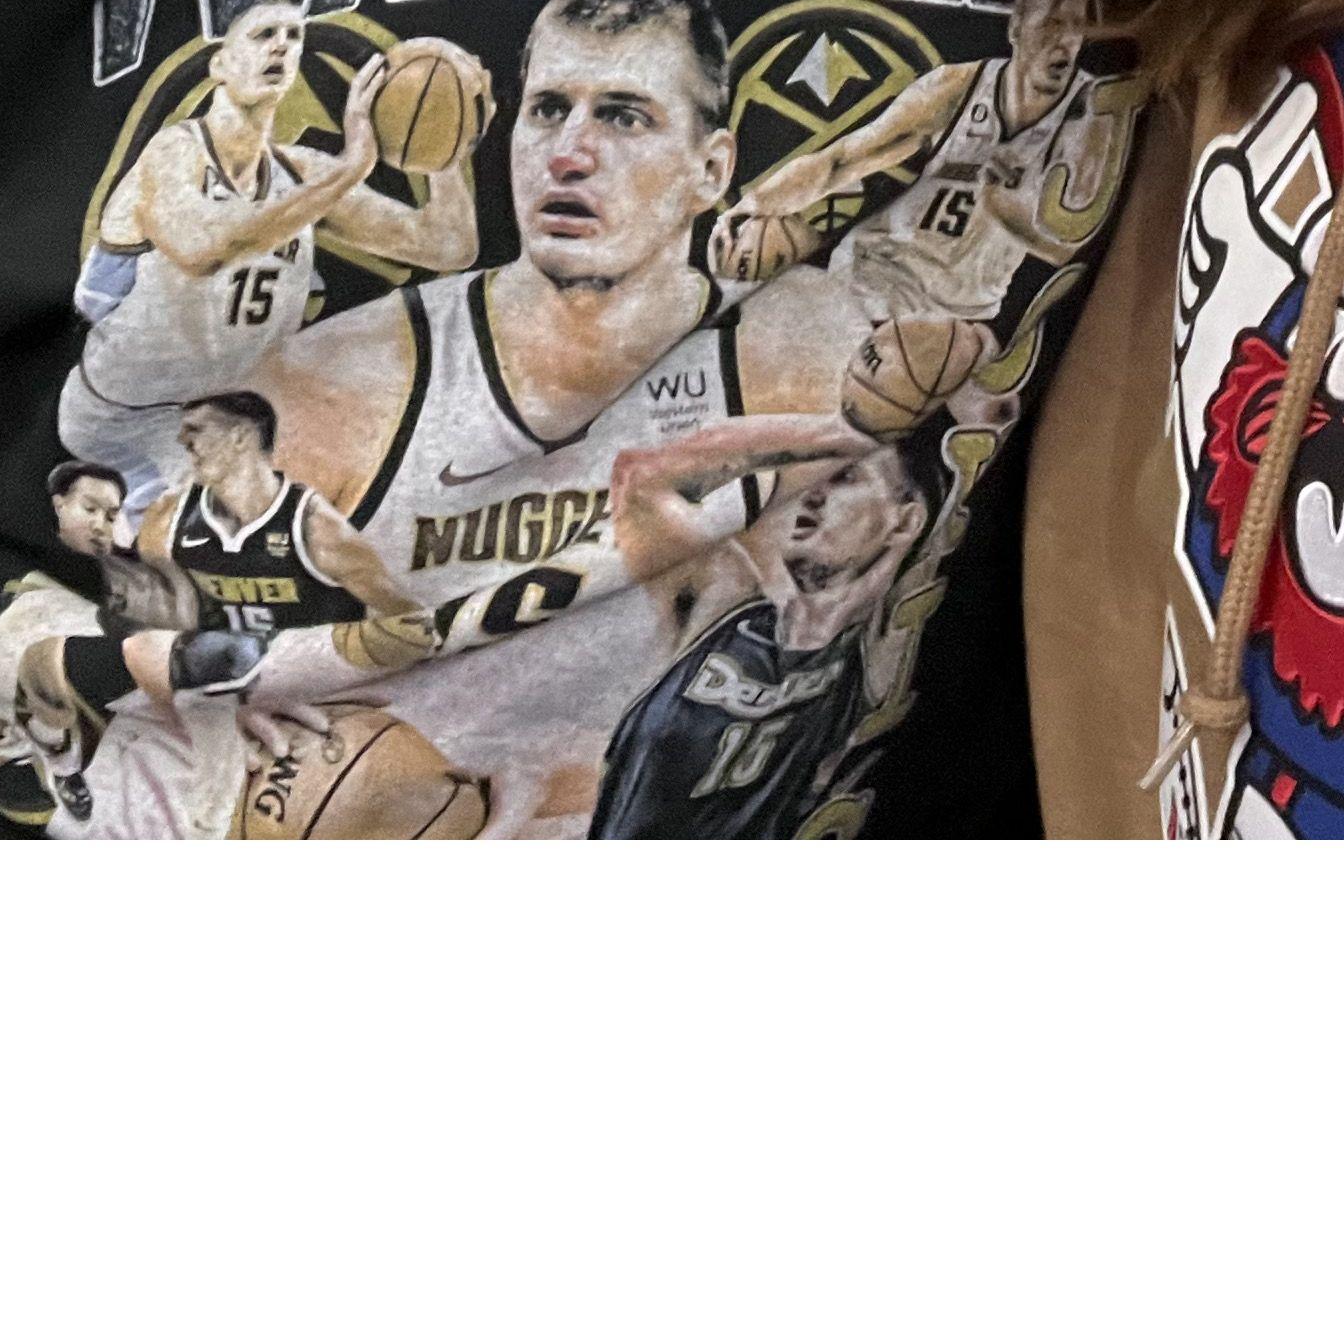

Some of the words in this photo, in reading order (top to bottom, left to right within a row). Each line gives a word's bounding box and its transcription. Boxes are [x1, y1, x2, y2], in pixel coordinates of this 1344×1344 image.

[919, 188, 976, 237] 15
[228, 267, 280, 326] 15
[646, 367, 706, 402] WU
